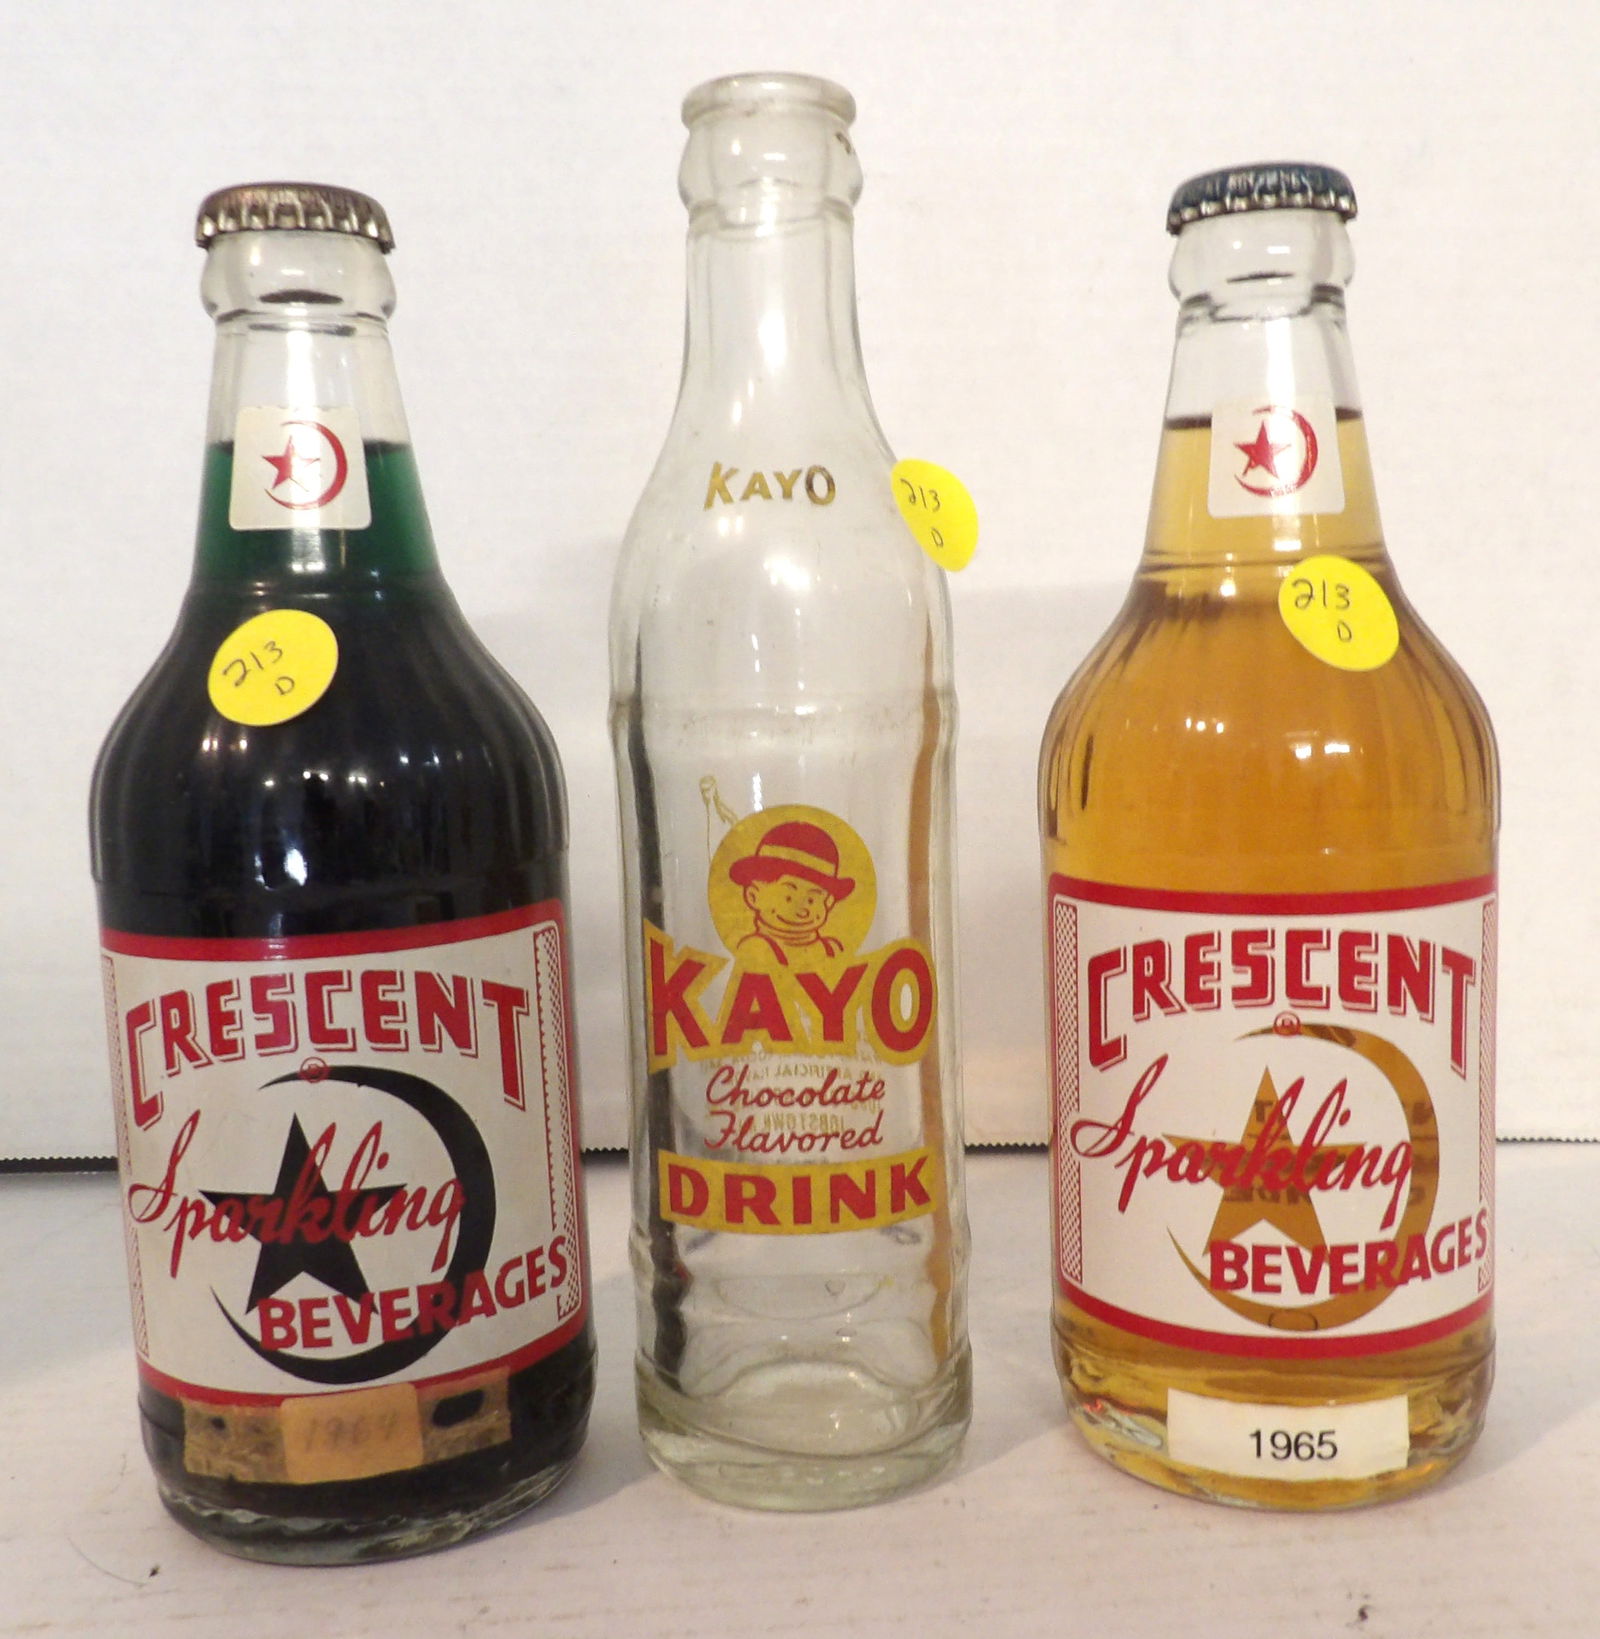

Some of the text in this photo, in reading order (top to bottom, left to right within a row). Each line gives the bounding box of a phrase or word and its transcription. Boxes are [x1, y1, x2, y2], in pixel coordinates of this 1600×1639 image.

[704, 461, 836, 511] KAYO
[900, 478, 941, 512] 213
[1292, 578, 1350, 610] 213
[222, 640, 284, 687] 213
[274, 676, 295, 695] D
[649, 937, 933, 1056] KAYO
[1087, 928, 1476, 1081] CRESCENT
[125, 969, 530, 1130] CRESCENT
[705, 1063, 886, 1107] Chocolate
[704, 1109, 884, 1153] Flavored
[1070, 1053, 1413, 1231] Sparkling
[127, 1108, 466, 1279] Sparkling
[668, 1156, 931, 1226] DRINK
[1208, 1207, 1488, 1295] BEVERAGES
[258, 1235, 568, 1350] BEVERAGES
[1248, 1428, 1338, 1461] 1965
